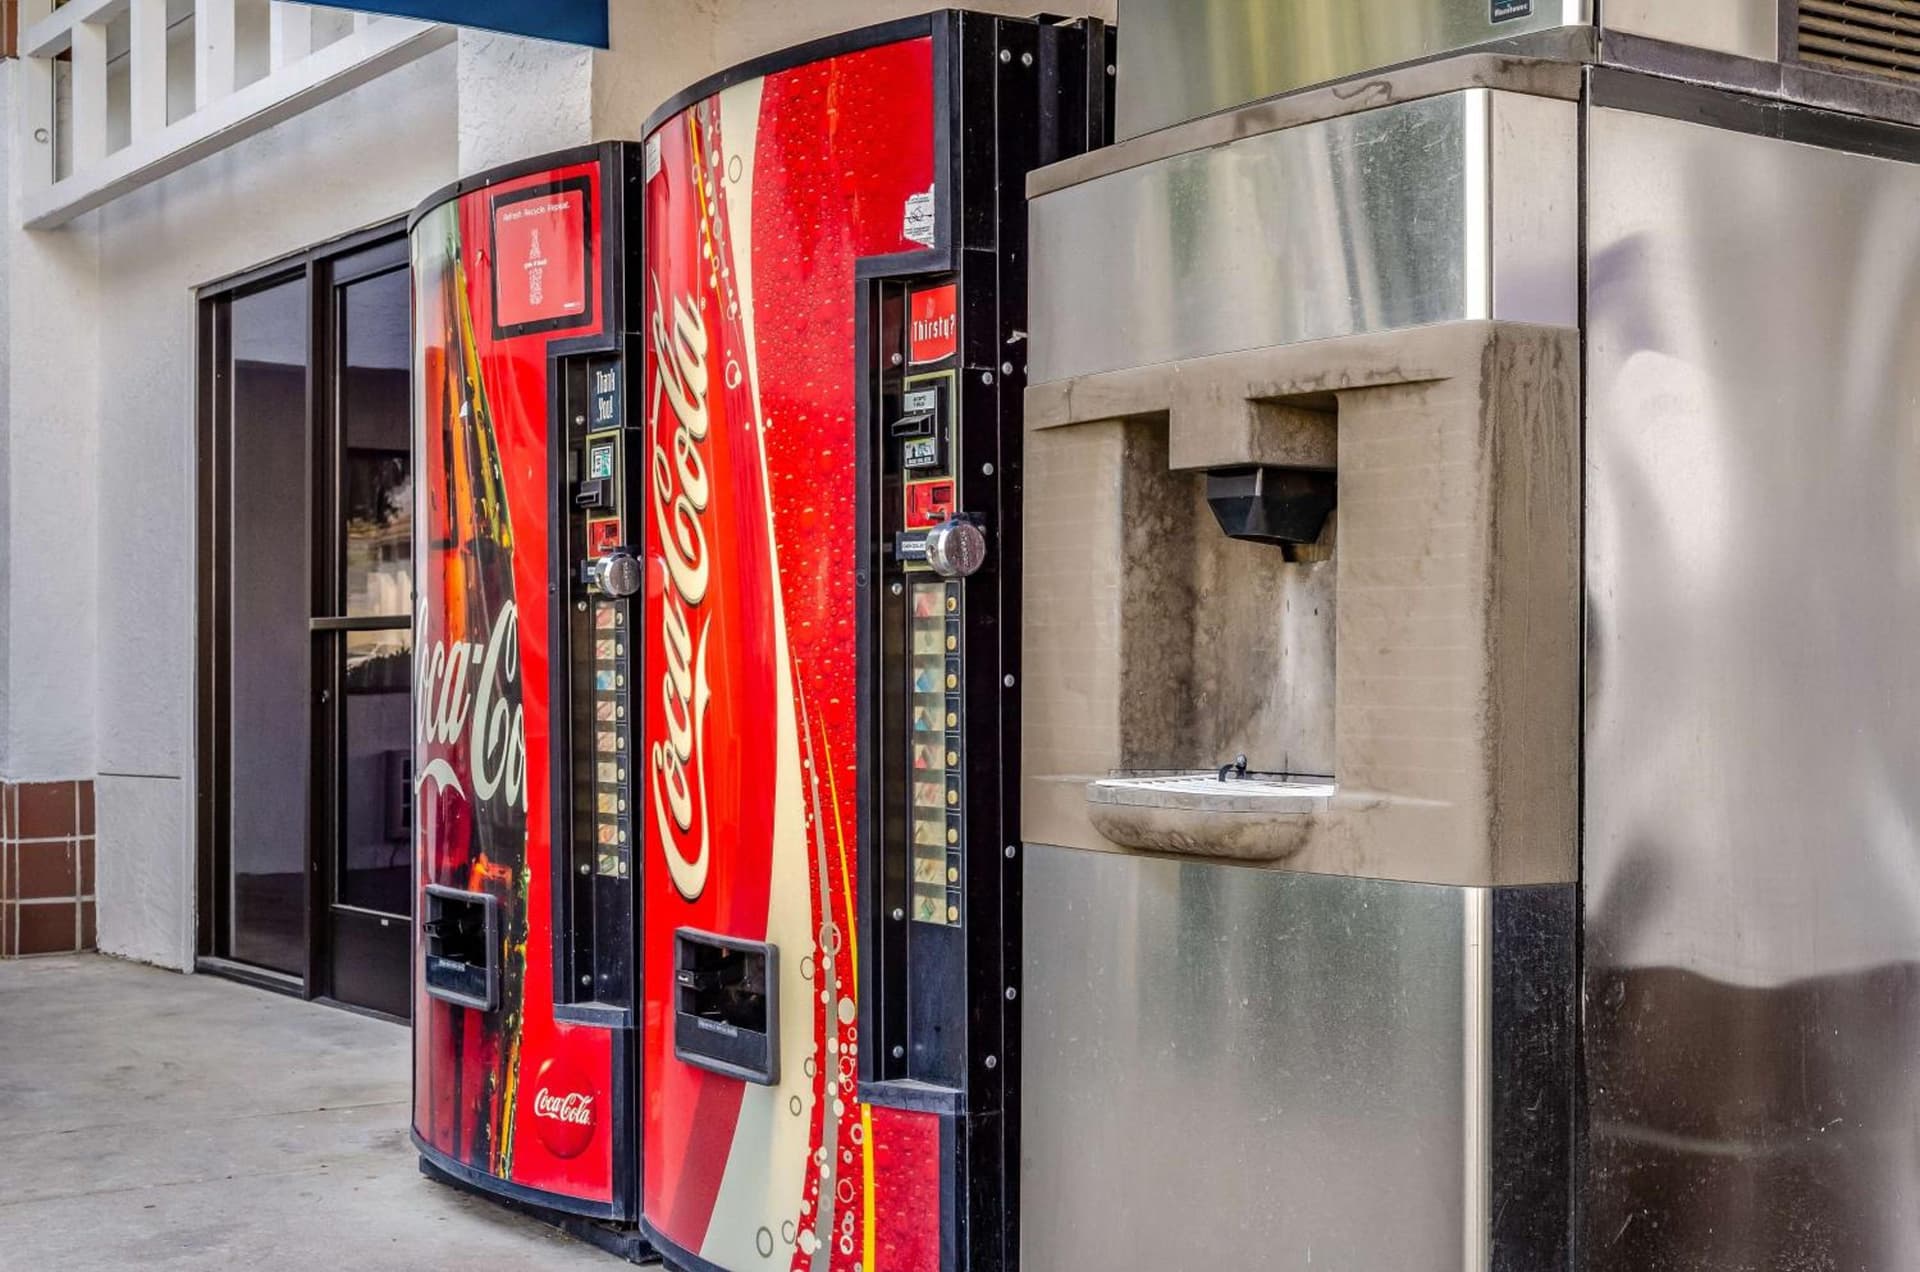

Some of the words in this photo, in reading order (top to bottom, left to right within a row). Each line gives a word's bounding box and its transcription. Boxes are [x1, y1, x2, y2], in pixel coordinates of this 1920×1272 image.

[913, 313, 955, 342] Thirsty?
[596, 368, 615, 394] Thank
[597, 395, 613, 421] You!
[651, 266, 713, 902] Coca-Cola
[534, 1087, 593, 1125] Coca-Cola
